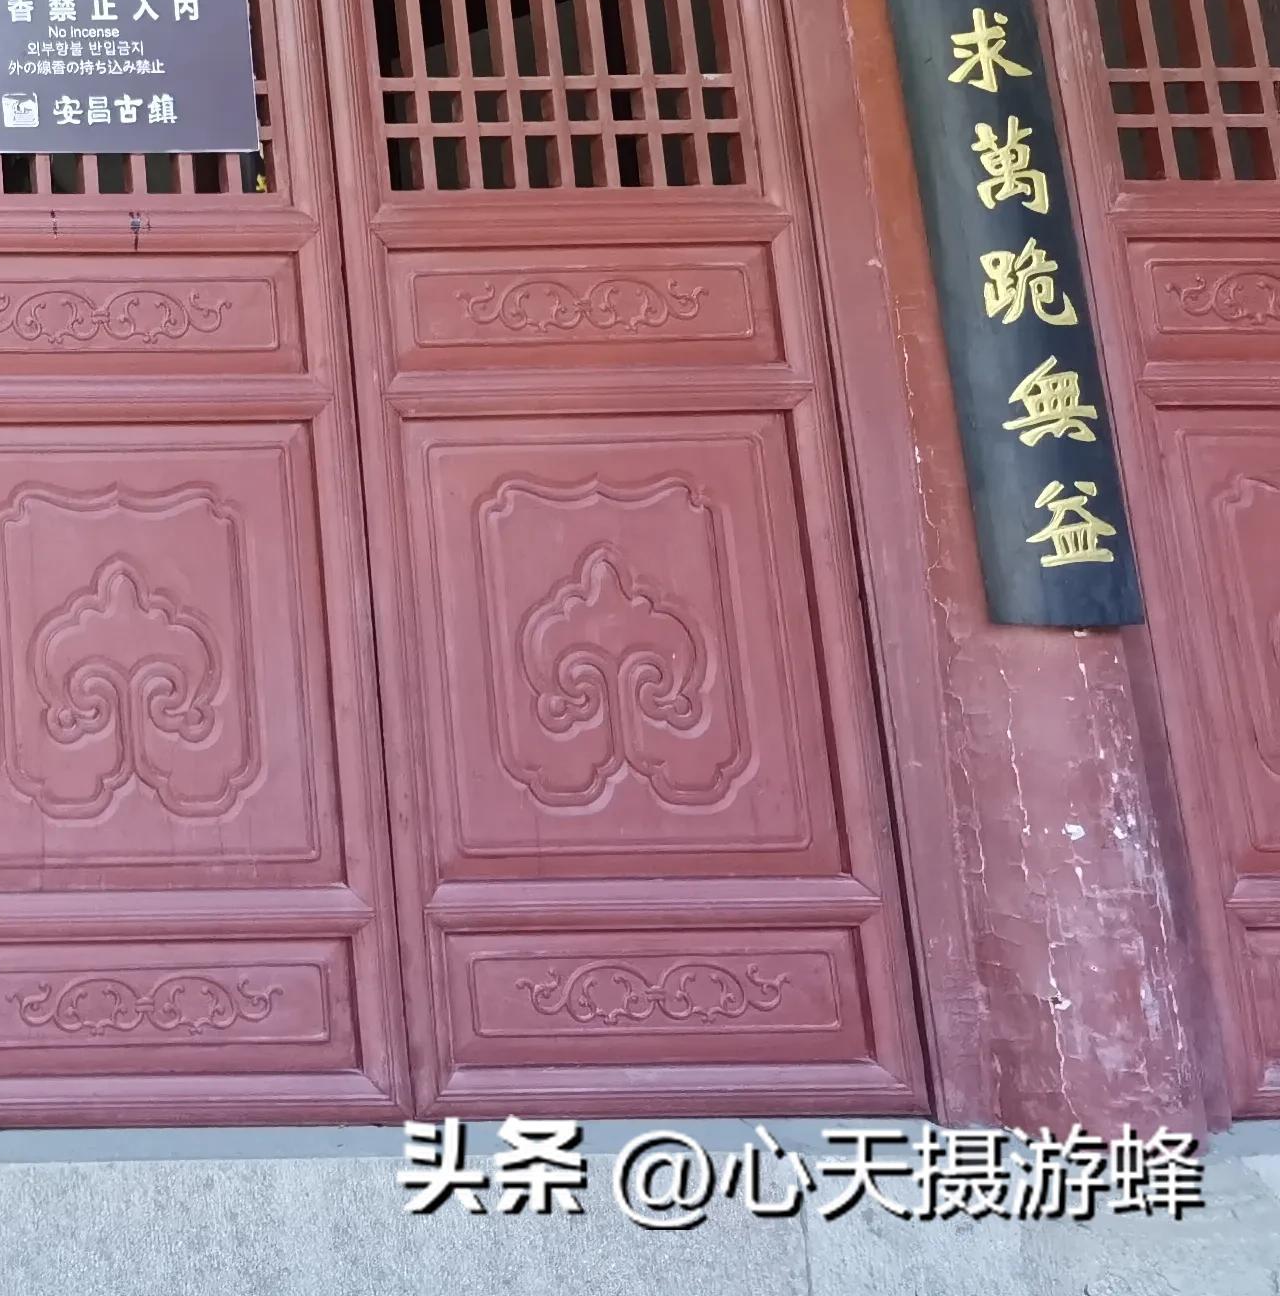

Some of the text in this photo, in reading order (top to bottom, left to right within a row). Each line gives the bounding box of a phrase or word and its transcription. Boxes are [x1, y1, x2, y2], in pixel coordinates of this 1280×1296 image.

[48, 26, 66, 38] No
[27, 40, 145, 56] 외부향불 반입금지
